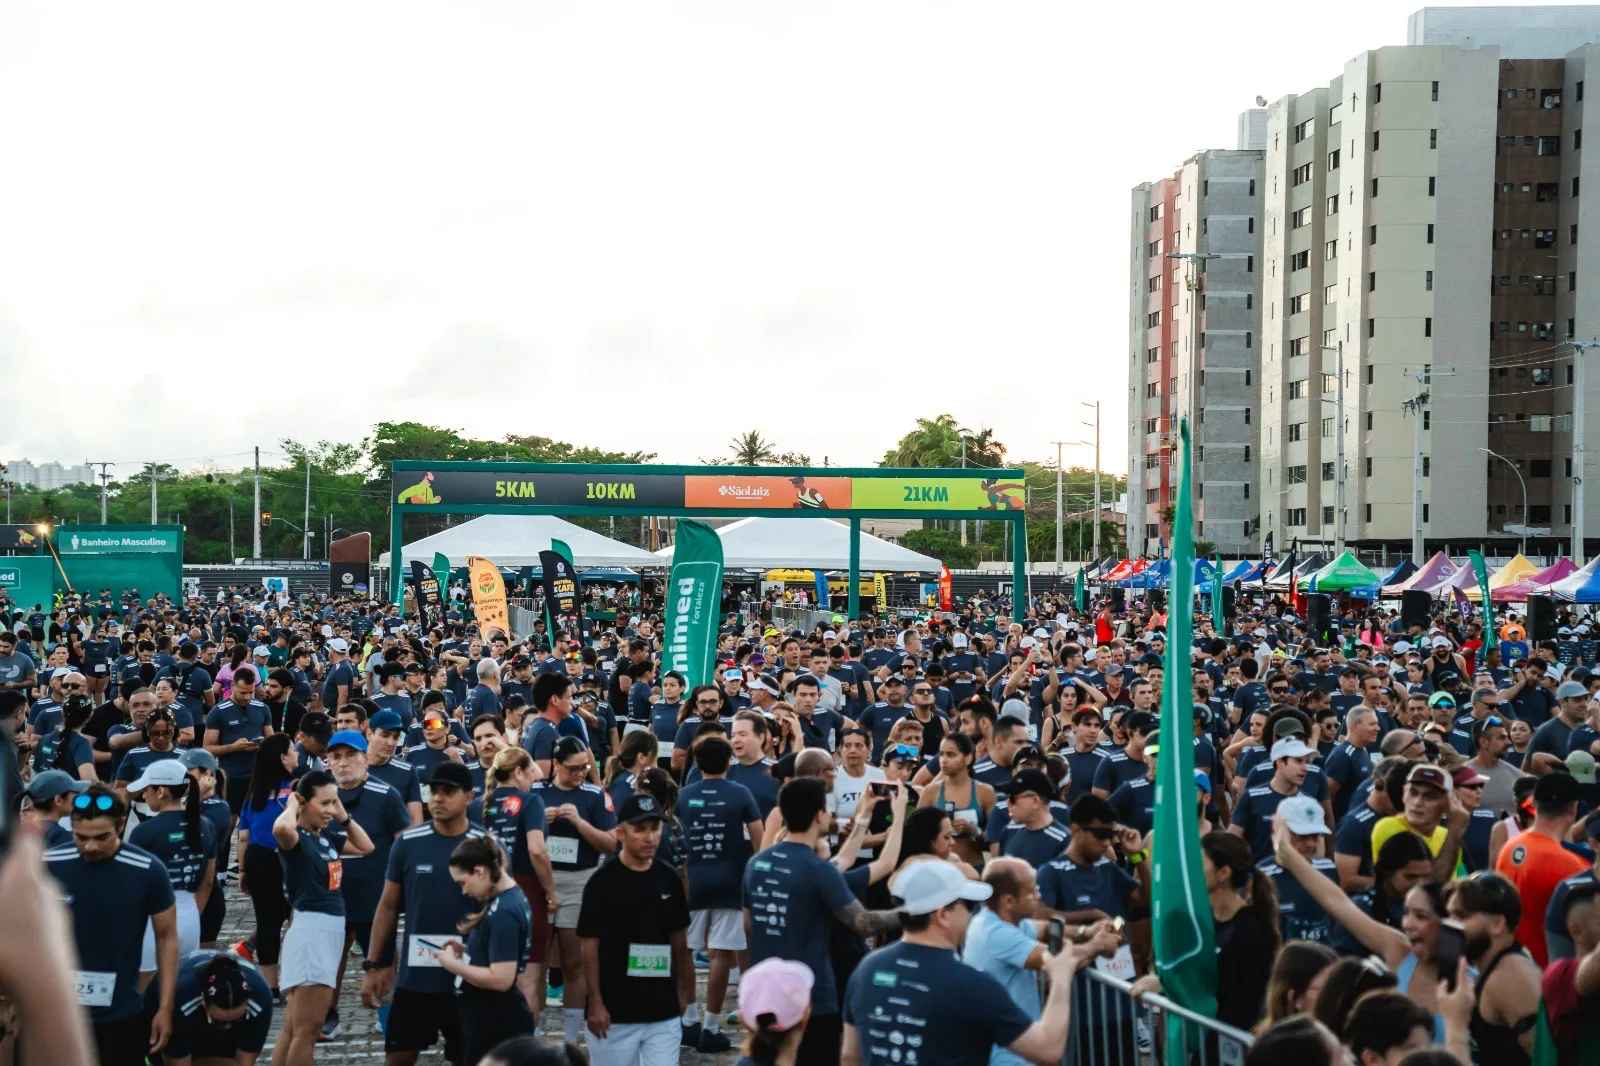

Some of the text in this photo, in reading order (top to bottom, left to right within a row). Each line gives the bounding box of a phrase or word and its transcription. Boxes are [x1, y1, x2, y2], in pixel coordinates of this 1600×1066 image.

[495, 480, 636, 499] 5KM 10KM
[903, 485, 949, 502] 21KM
[81, 537, 166, 546] Banheiro Masculino
[692, 582, 705, 625] Fortaleza
